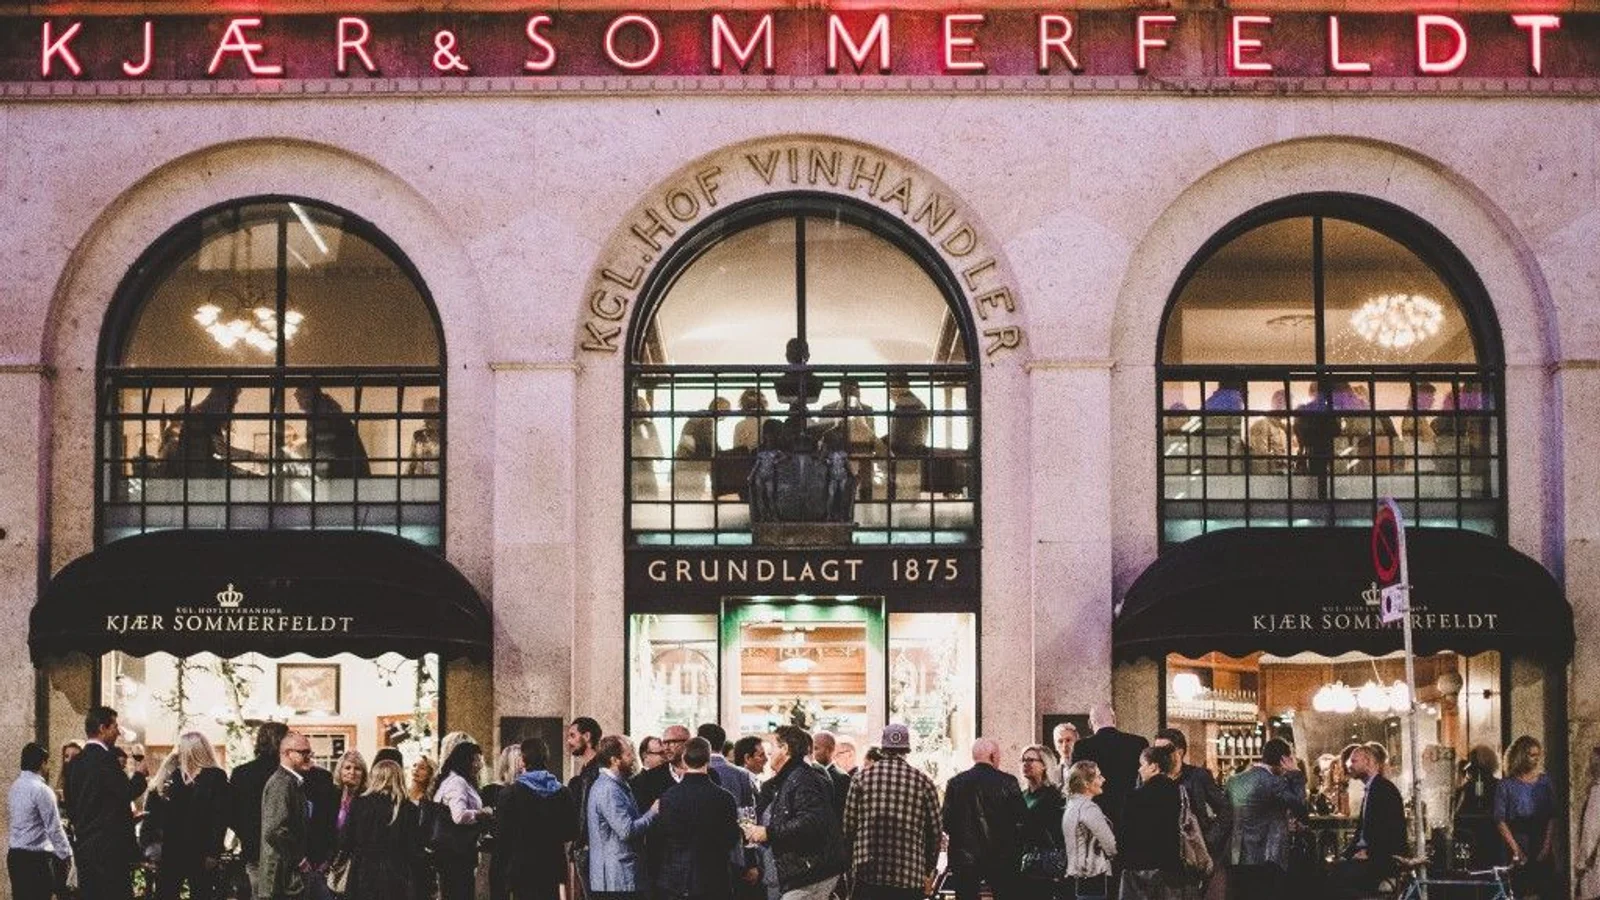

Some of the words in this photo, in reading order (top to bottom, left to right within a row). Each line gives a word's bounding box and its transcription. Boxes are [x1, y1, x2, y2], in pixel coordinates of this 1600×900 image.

[41, 17, 376, 77] KJÆR
[431, 30, 470, 72] &
[523, 13, 1562, 76] SOMMERFELDT
[745, 147, 1021, 357] VINHANDLER
[647, 559, 864, 582] GRUNDLAGT
[892, 558, 959, 582] 1875
[106, 614, 164, 634] KJÆR
[173, 614, 354, 633] SOMMERFELDT
[1252, 613, 1313, 633] KJÆR
